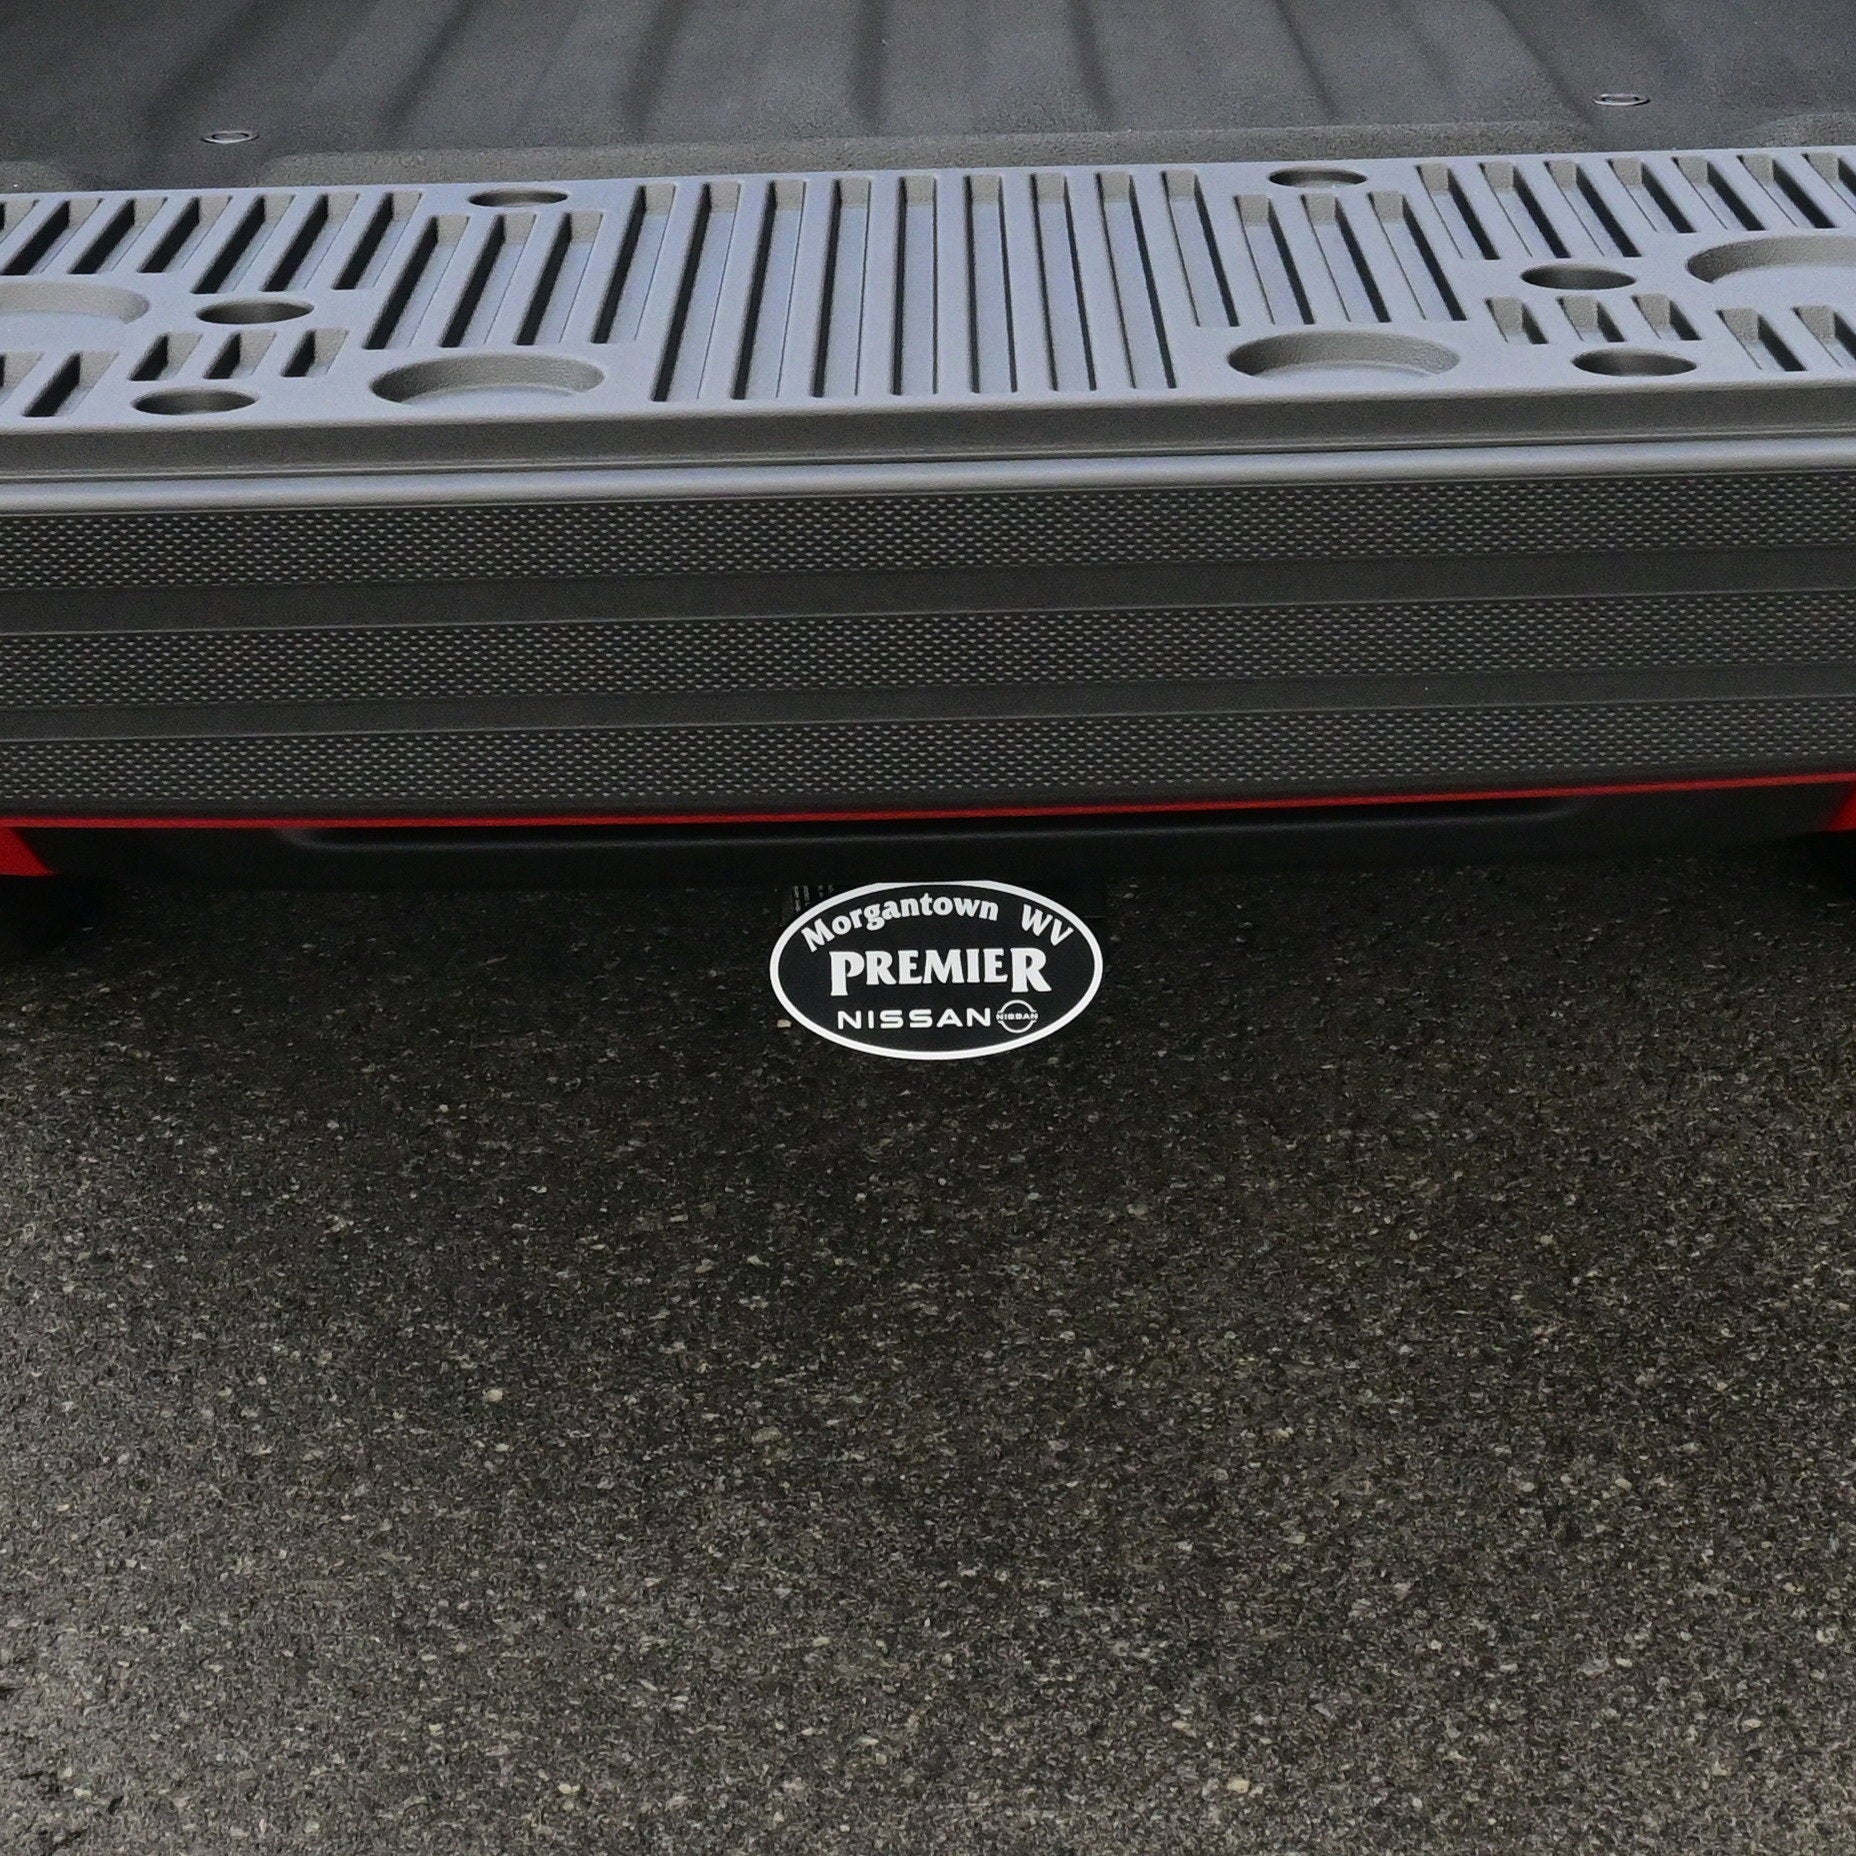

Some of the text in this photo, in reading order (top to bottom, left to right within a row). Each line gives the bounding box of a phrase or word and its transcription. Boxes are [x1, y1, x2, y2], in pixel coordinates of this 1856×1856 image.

[801, 893, 1074, 952] Morgantown WV
[829, 947, 1052, 996] PREMIER
[838, 1007, 991, 1030] NISSAN
